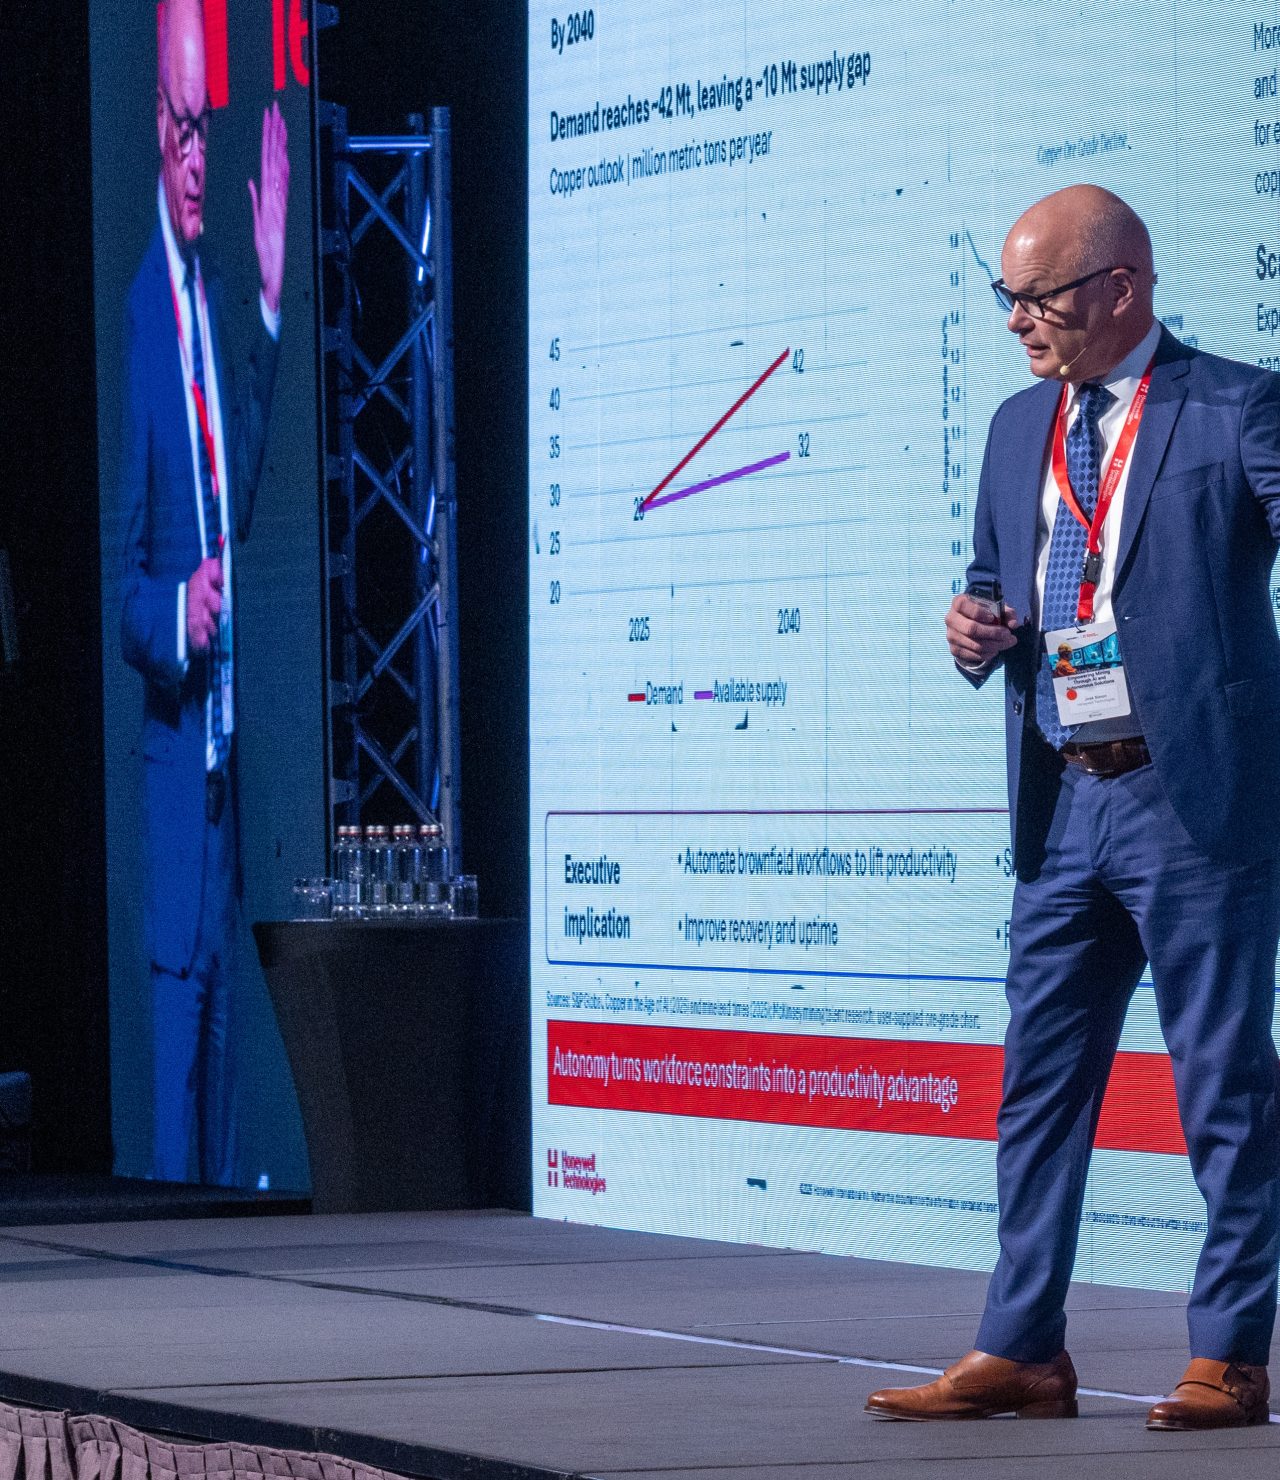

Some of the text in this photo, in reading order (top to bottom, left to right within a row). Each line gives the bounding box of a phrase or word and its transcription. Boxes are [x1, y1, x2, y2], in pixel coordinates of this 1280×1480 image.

[552, 9, 595, 55] By 2040
[551, 50, 871, 142] Demand reaches ~42 Mt, leaving a ~10 Mt supply gap
[1254, 68, 1278, 99] and
[1254, 119, 1271, 146] for
[550, 167, 586, 198] Copper
[588, 154, 624, 188] outlook
[632, 147, 666, 179] million
[668, 138, 701, 172] metric
[703, 139, 726, 166] tons
[729, 136, 747, 167] per
[749, 130, 772, 164] year
[549, 338, 561, 361] 45
[792, 349, 805, 374] 42
[549, 387, 560, 411] 40
[549, 435, 561, 458] 35
[798, 433, 811, 457] 32
[549, 484, 561, 507] 30
[549, 531, 561, 555] 25
[549, 581, 561, 604] 20
[629, 617, 650, 641] 2025
[777, 608, 801, 634] 2040
[646, 680, 683, 705] Demand
[713, 676, 787, 706] Available supply
[565, 854, 621, 885] Executive
[684, 845, 957, 884] Automate brownfield workflows to lift productivity
[565, 906, 631, 945] implication
[685, 913, 838, 951] Improve recovery and uptime
[553, 1045, 958, 1112] Autonomy turns workforce constraints into a productivity advantage
[562, 1151, 595, 1174] Honeywell
